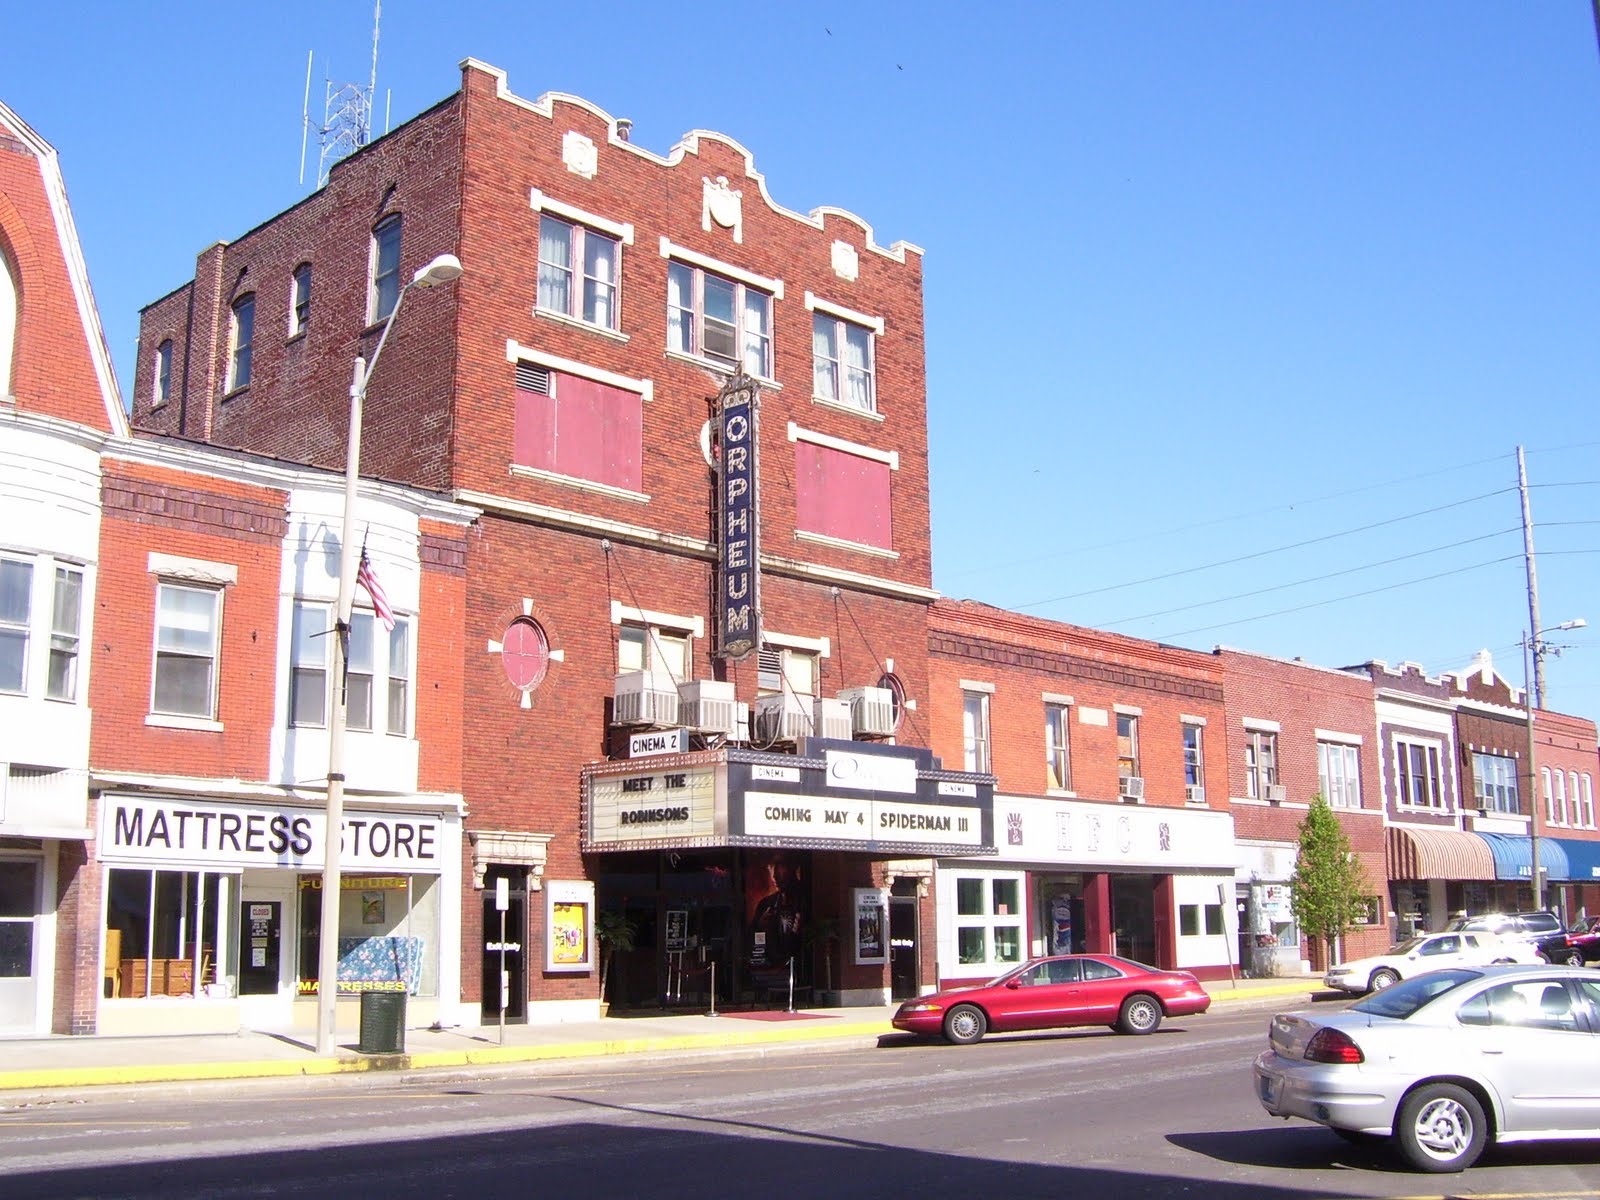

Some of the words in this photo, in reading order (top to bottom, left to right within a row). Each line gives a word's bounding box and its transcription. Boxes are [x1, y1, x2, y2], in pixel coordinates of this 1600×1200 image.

[726, 415, 749, 632] ORPHEUM
[632, 738, 666, 753] CINEMA
[670, 735, 677, 749] 2
[759, 768, 784, 778] CINEMA
[623, 777, 653, 793] MEET
[664, 773, 687, 789] THE
[621, 806, 689, 825] ROBINSONS
[764, 806, 812, 823] COMING
[825, 810, 849, 824] MAY
[857, 812, 864, 825] 4
[880, 812, 951, 831] SPIDERMAN
[115, 807, 312, 855] MATTRESS
[299, 877, 408, 889] FUNITURE
[298, 981, 407, 992] MARESSES
